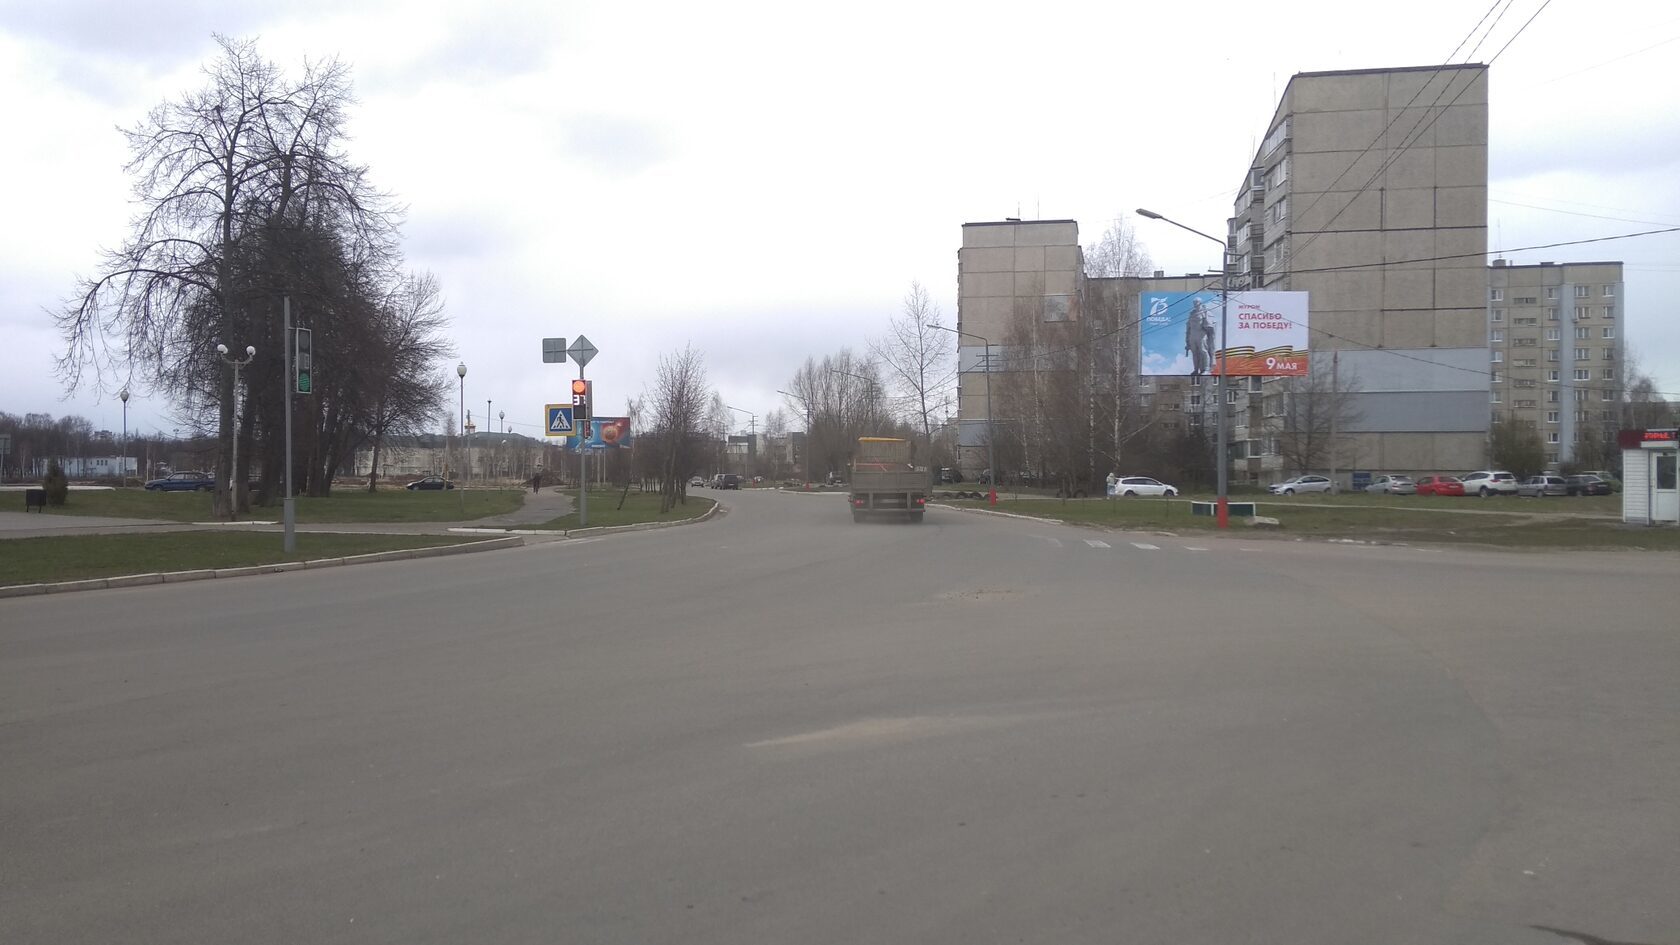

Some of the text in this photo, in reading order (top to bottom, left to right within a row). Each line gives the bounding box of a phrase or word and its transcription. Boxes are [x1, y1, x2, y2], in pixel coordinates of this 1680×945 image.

[1238, 312, 1282, 321] СПАСИБО
[1252, 321, 1293, 330] ПОБЕДУ!
[1266, 357, 1297, 370] 9 МАЯ
